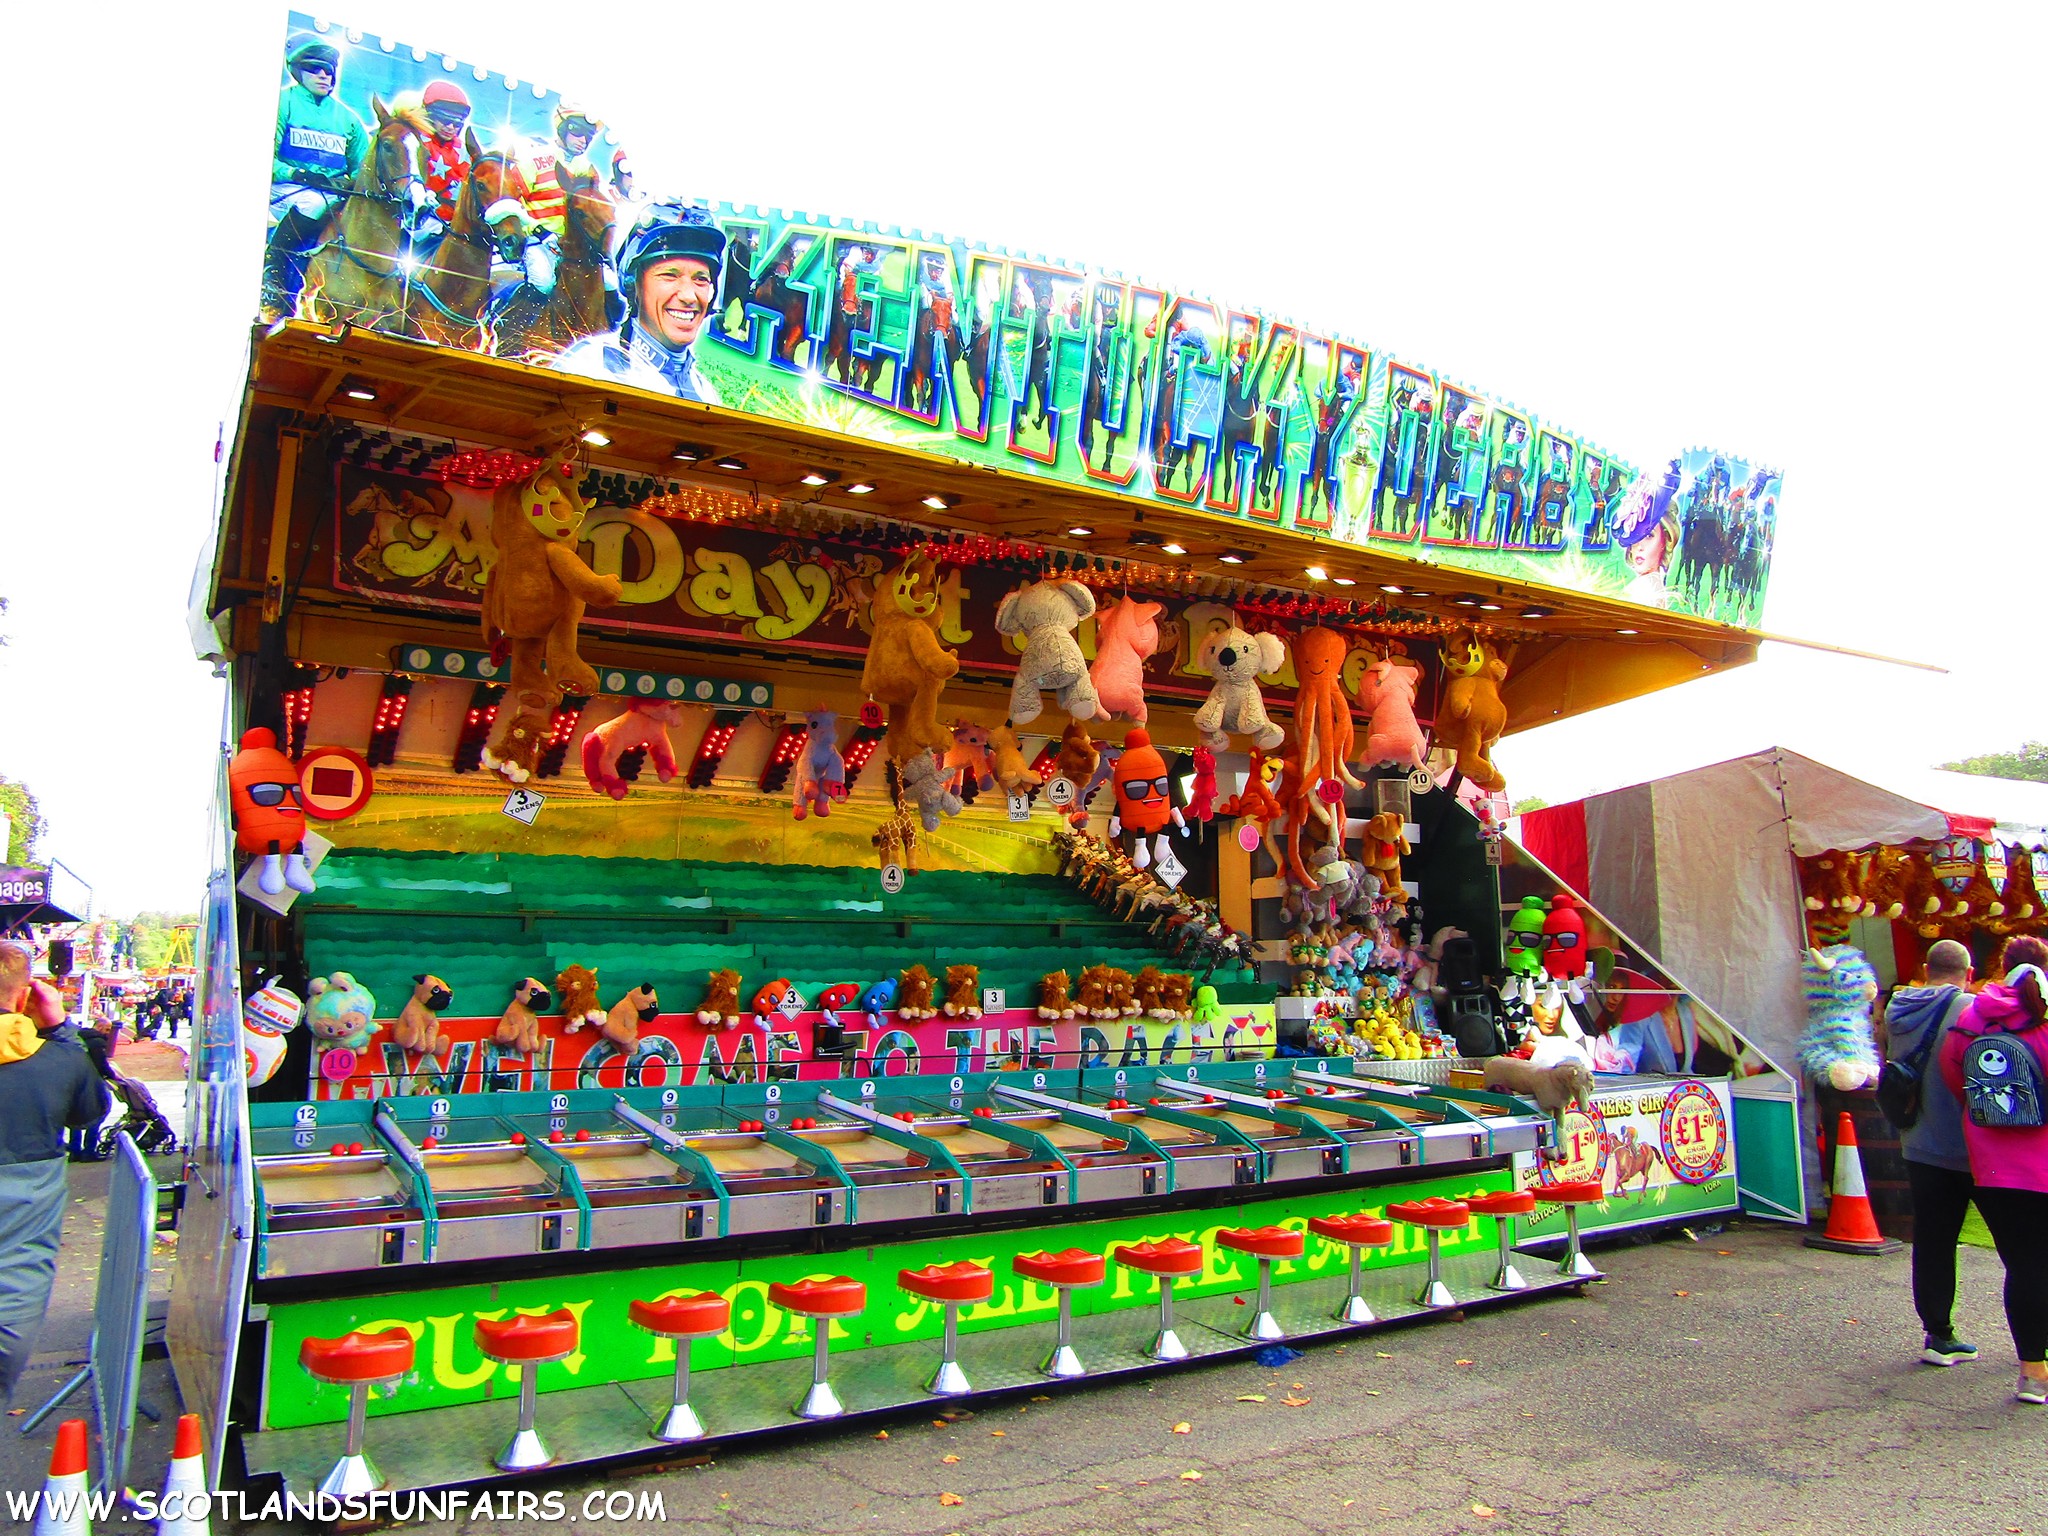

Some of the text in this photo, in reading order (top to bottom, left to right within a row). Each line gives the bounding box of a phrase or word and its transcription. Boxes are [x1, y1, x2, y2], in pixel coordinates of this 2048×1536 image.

[292, 131, 344, 152] DAWSON
[705, 216, 1634, 552] KENTUCKY DERBY
[580, 505, 832, 640] Day
[450, 657, 459, 671] 2
[864, 706, 878, 718] 10
[1412, 773, 1428, 785] 10
[836, 785, 842, 793] 7
[1055, 782, 1066, 794] 4
[1323, 782, 1341, 796] 10
[514, 789, 528, 805] 3
[1015, 797, 1022, 810] 3
[509, 800, 540, 815] TOKENS
[1011, 810, 1028, 819] TOKENS
[1490, 845, 1495, 855] 4
[1165, 857, 1175, 871] 4
[888, 868, 896, 882] 4
[0, 880, 44, 902] ages
[787, 990, 796, 1003] 3
[991, 991, 998, 1003] 3
[329, 1053, 351, 1069] 10
[381, 1031, 803, 1098] WELCOME
[946, 1026, 1058, 1075] THE
[299, 1108, 315, 1119] 12
[434, 1102, 447, 1113] 11
[553, 1098, 567, 1107] 10
[667, 1091, 674, 1102] 9
[770, 1087, 777, 1098] 8
[865, 1083, 872, 1093] 7
[953, 1079, 960, 1089] 6
[1036, 1075, 1043, 1085] 5
[1117, 1072, 1124, 1082] 4
[1189, 1068, 1195, 1079] 3
[1257, 1065, 1263, 1075] 2
[1593, 1095, 1633, 1118] NERS
[1675, 1113, 1714, 1146] £1.50
